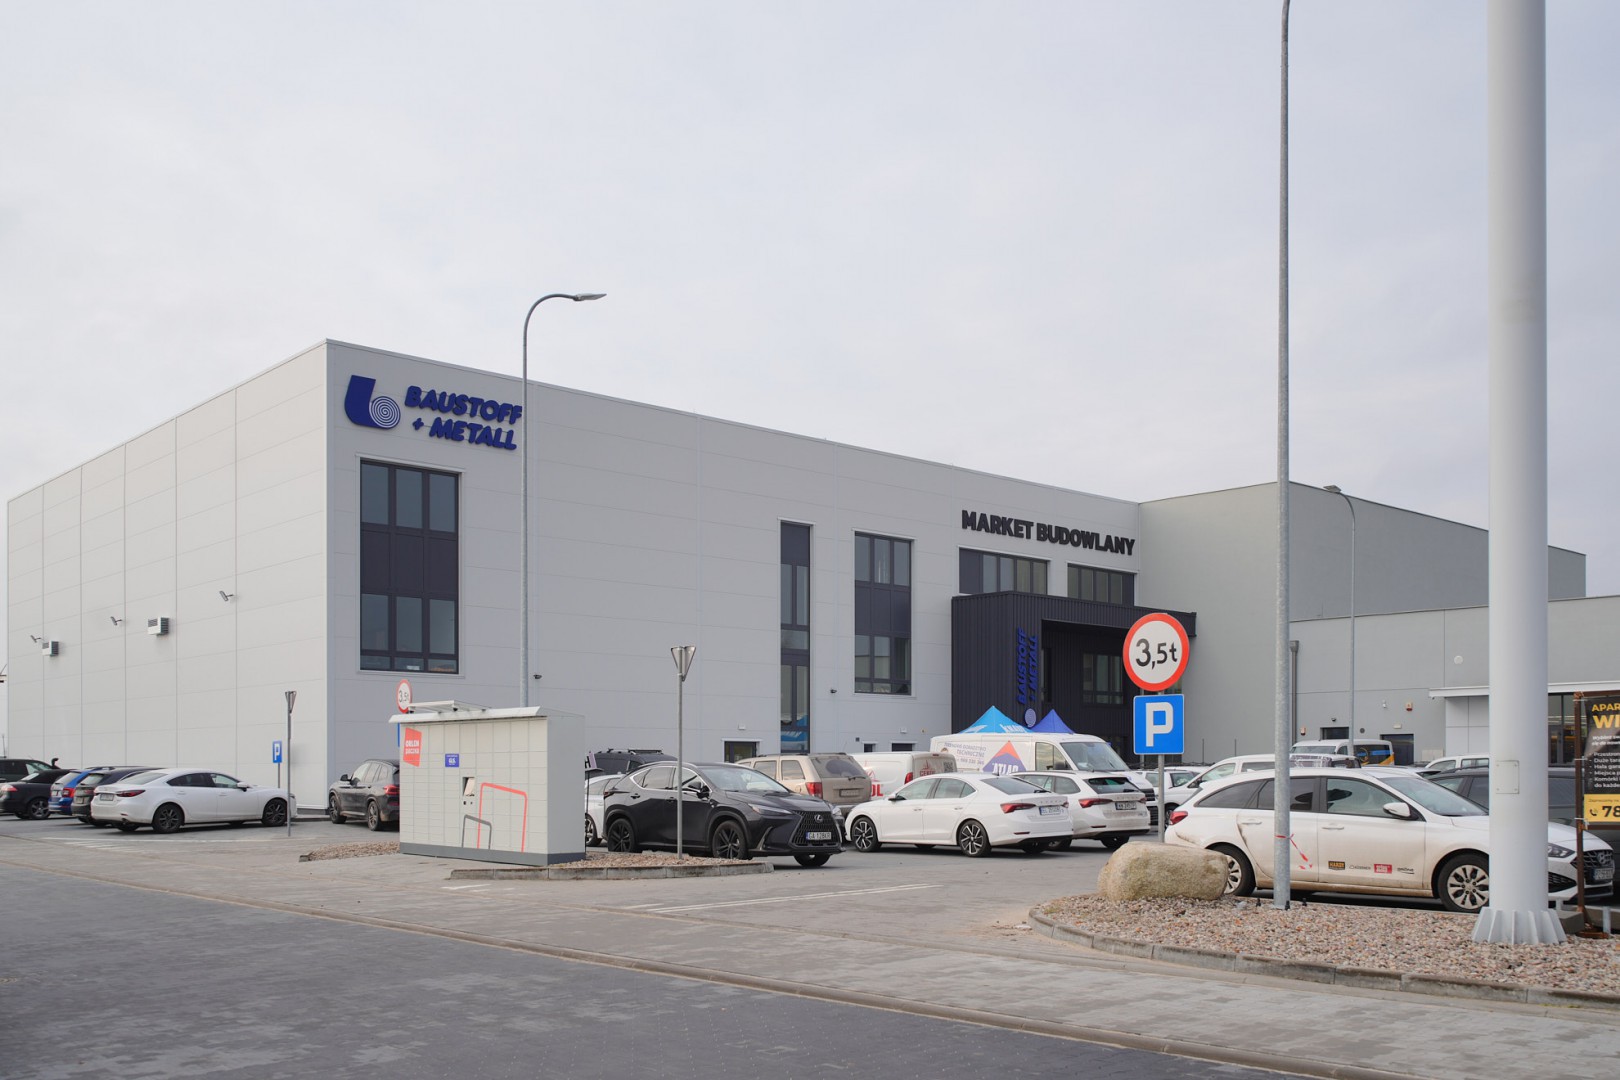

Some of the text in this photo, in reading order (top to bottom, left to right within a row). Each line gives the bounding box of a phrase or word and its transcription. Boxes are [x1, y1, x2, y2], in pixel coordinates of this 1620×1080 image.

[405, 385, 522, 425] BAUSTOFF
[429, 417, 517, 450] METALL
[962, 510, 1135, 555] MARKET BUDOWLANY
[1136, 638, 1178, 669] 3,5t
[1145, 702, 1174, 747] P
